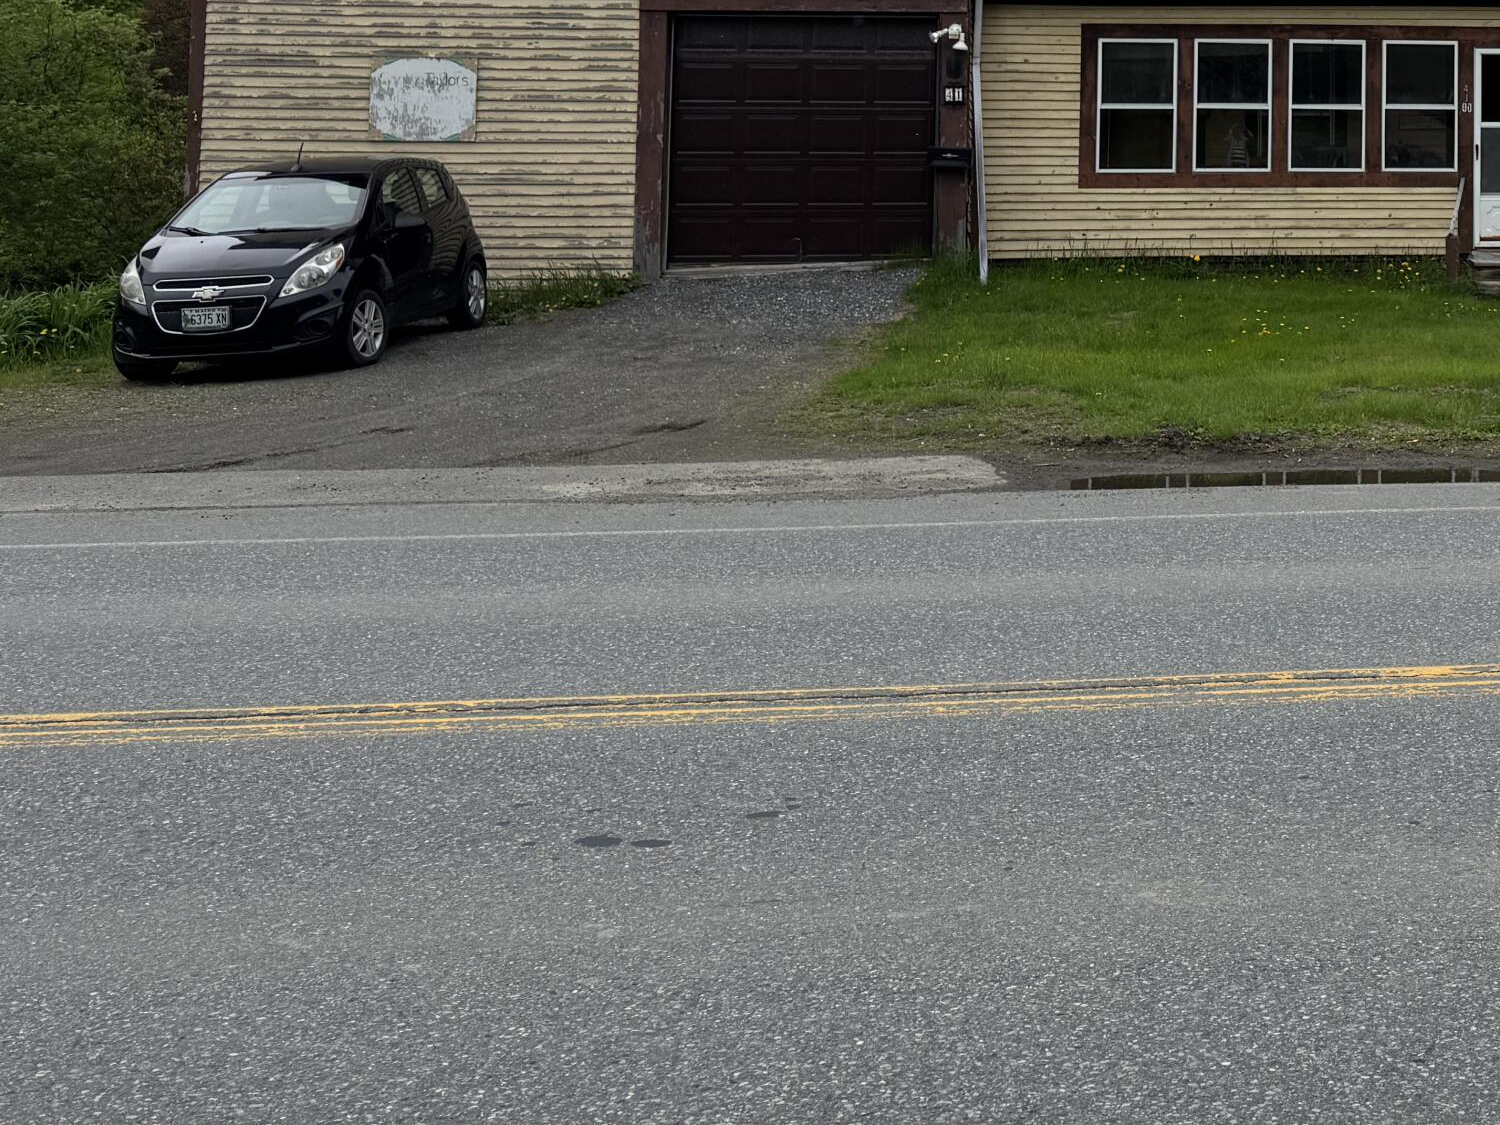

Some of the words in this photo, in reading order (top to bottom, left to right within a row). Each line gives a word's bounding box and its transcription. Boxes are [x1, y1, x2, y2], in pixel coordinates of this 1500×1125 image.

[946, 89, 961, 100] 41
[190, 313, 213, 325] 6375
[216, 312, 227, 324] XN
